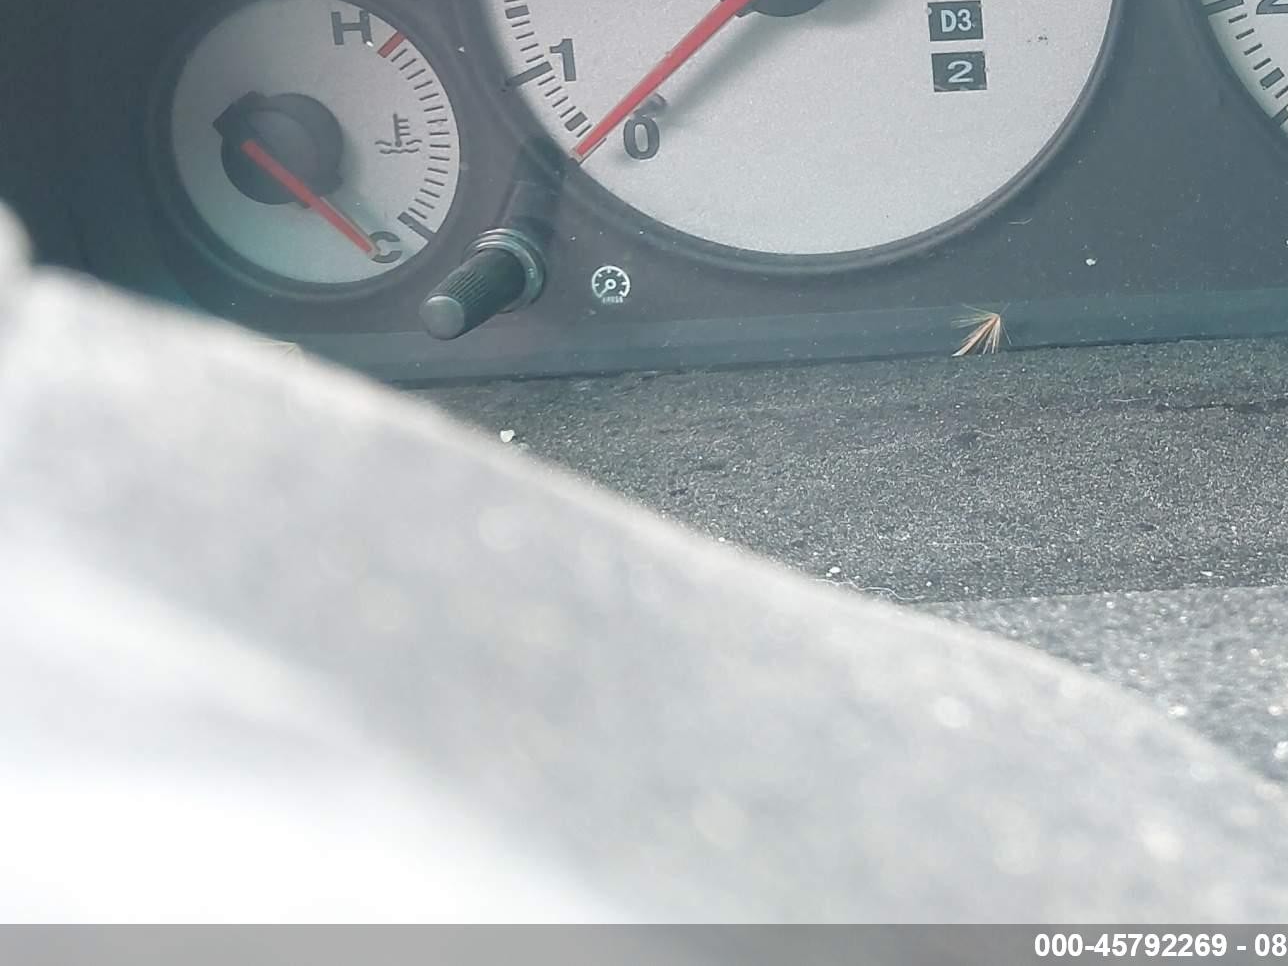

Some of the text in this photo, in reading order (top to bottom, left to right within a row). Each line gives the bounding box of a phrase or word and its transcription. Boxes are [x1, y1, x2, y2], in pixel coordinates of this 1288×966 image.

[330, 10, 373, 46] H
[940, 8, 972, 33] D3
[549, 37, 577, 82] 1
[947, 60, 975, 83] 2
[622, 114, 660, 161] 0
[367, 230, 403, 264] C
